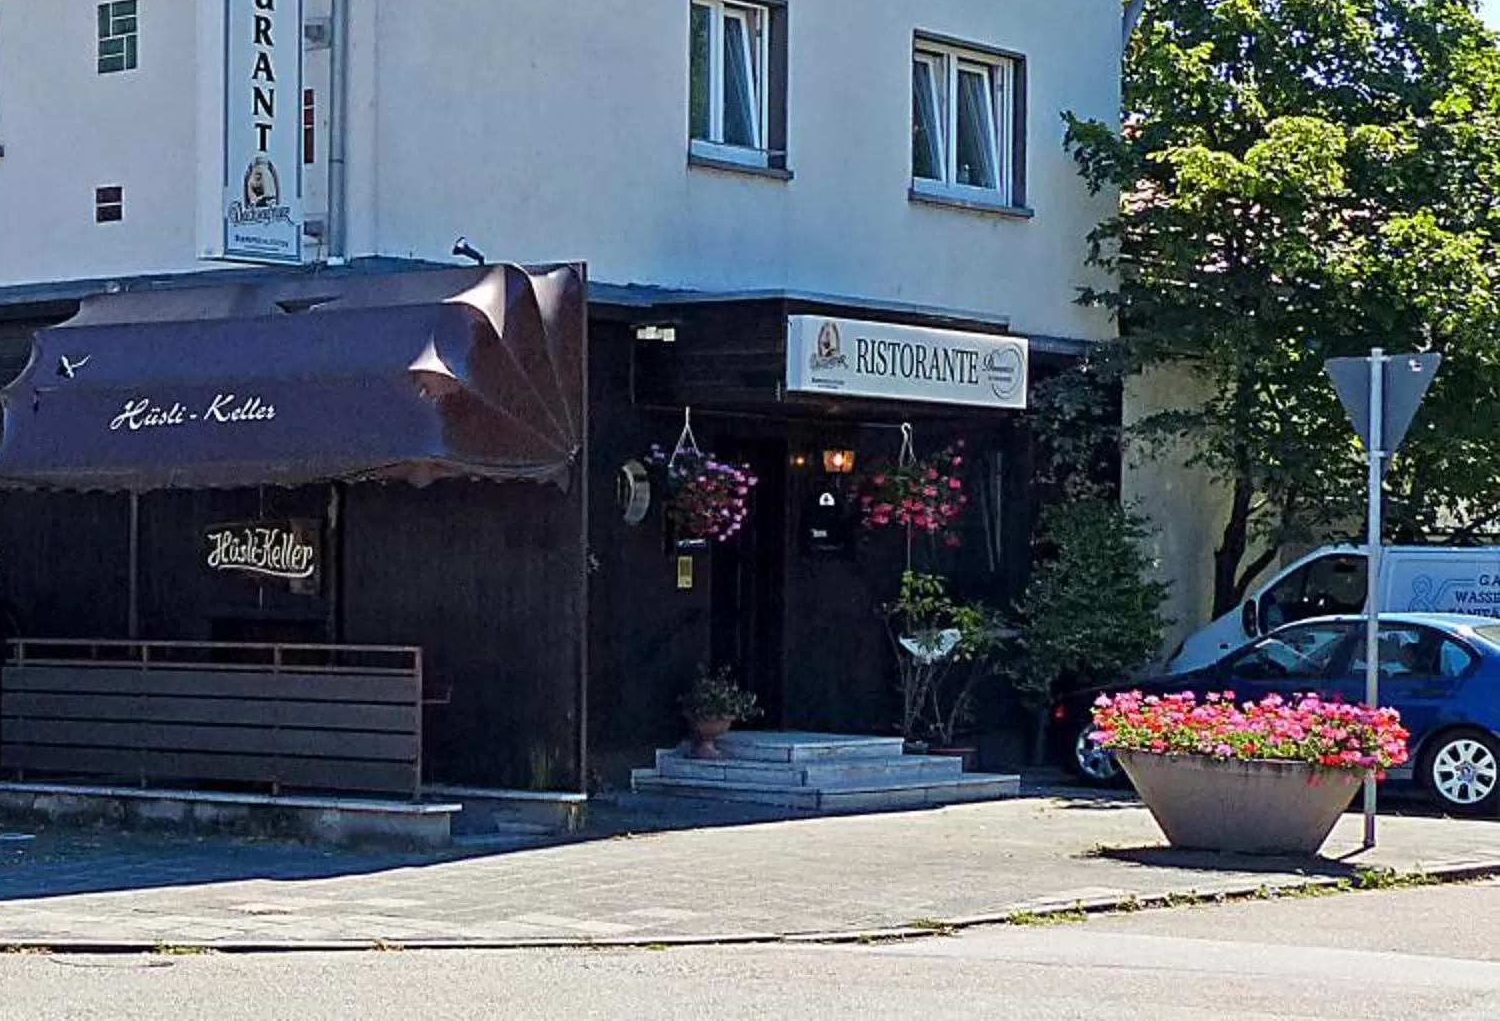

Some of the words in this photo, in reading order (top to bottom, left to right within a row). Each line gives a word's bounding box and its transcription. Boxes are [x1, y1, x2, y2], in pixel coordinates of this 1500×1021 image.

[856, 338, 979, 384] RISTORANTE
[110, 399, 187, 430] Hüsli
[204, 393, 276, 423] Keller
